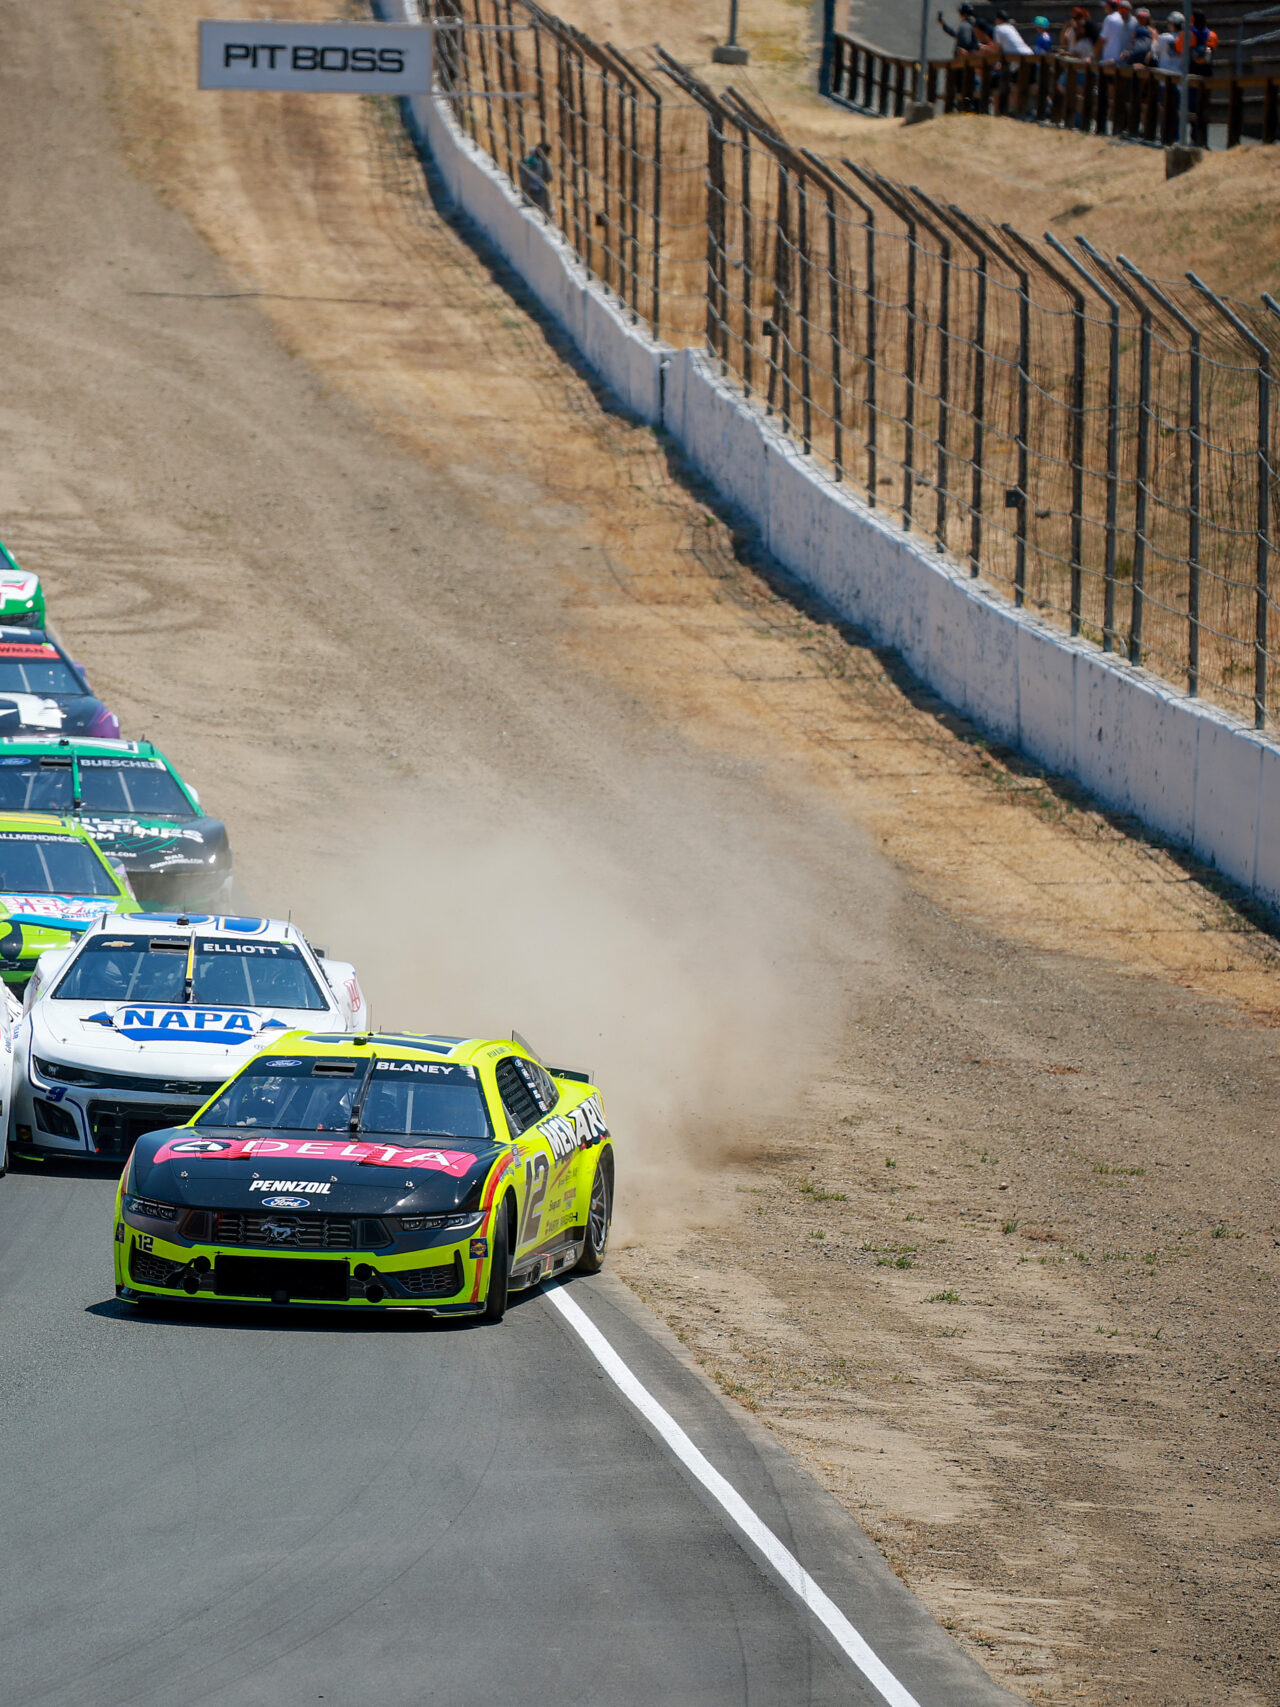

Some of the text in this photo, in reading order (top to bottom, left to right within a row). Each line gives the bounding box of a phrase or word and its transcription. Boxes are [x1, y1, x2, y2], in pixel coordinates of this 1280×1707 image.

[224, 43, 405, 73] PIT BOSS
[80, 759, 159, 769] BUESCHER
[202, 943, 280, 955] ELLIOTT
[123, 1009, 254, 1032] NAPA
[376, 1061, 455, 1075] BLANEY
[241, 1140, 458, 1168] DELTA
[248, 1179, 332, 1195] PENNZOIL
[518, 1149, 551, 1251] 12
[137, 1233, 155, 1252] 12
